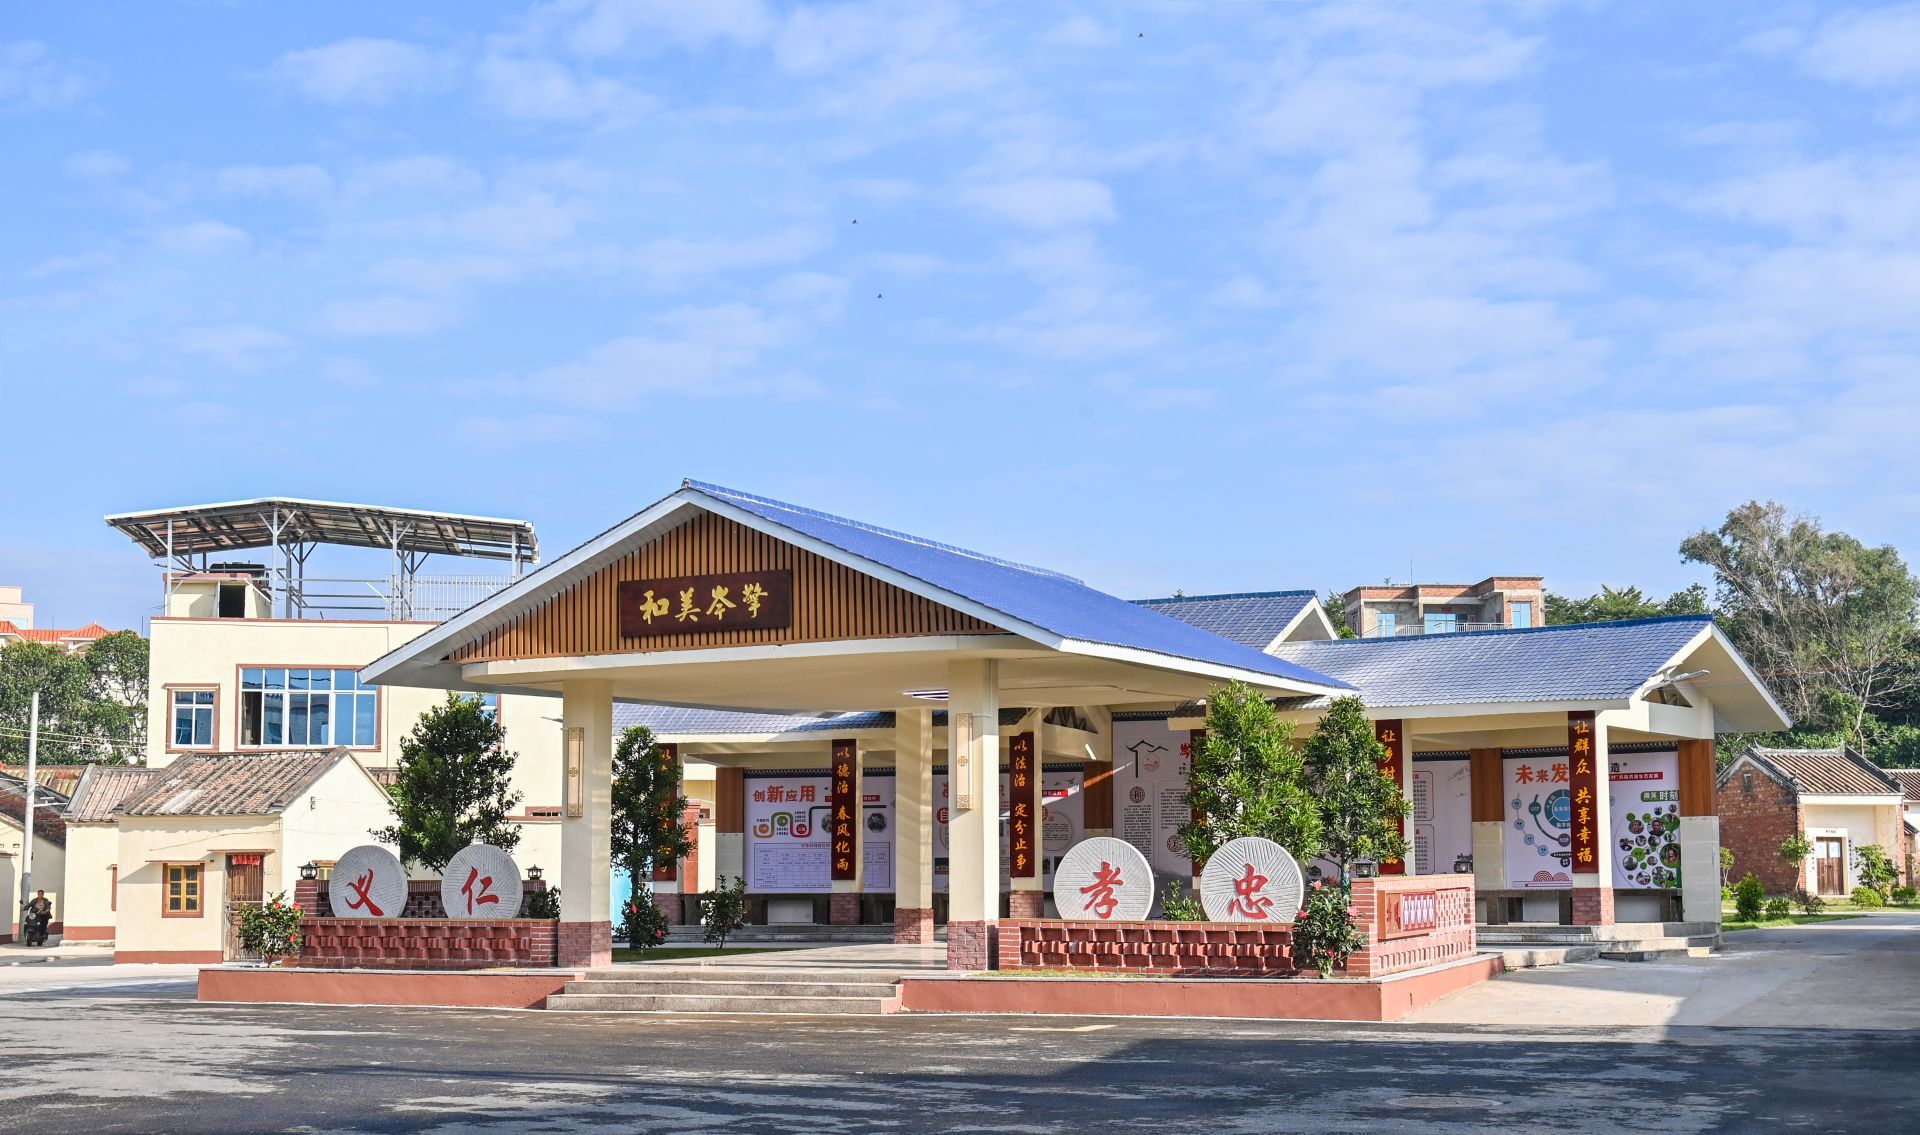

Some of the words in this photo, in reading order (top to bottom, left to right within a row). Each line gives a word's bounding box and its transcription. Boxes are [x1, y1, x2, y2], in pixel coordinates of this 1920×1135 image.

[639, 582, 769, 625] 和美岑擎
[752, 784, 816, 803] 创新应用
[835, 805, 851, 871] 春风化雨
[1014, 802, 1029, 869] 定分止争
[1575, 786, 1593, 862] 共享幸福
[344, 866, 385, 917] 义
[461, 866, 499, 916] 仁
[1080, 860, 1124, 919] 孝
[1229, 863, 1274, 919] 忠
